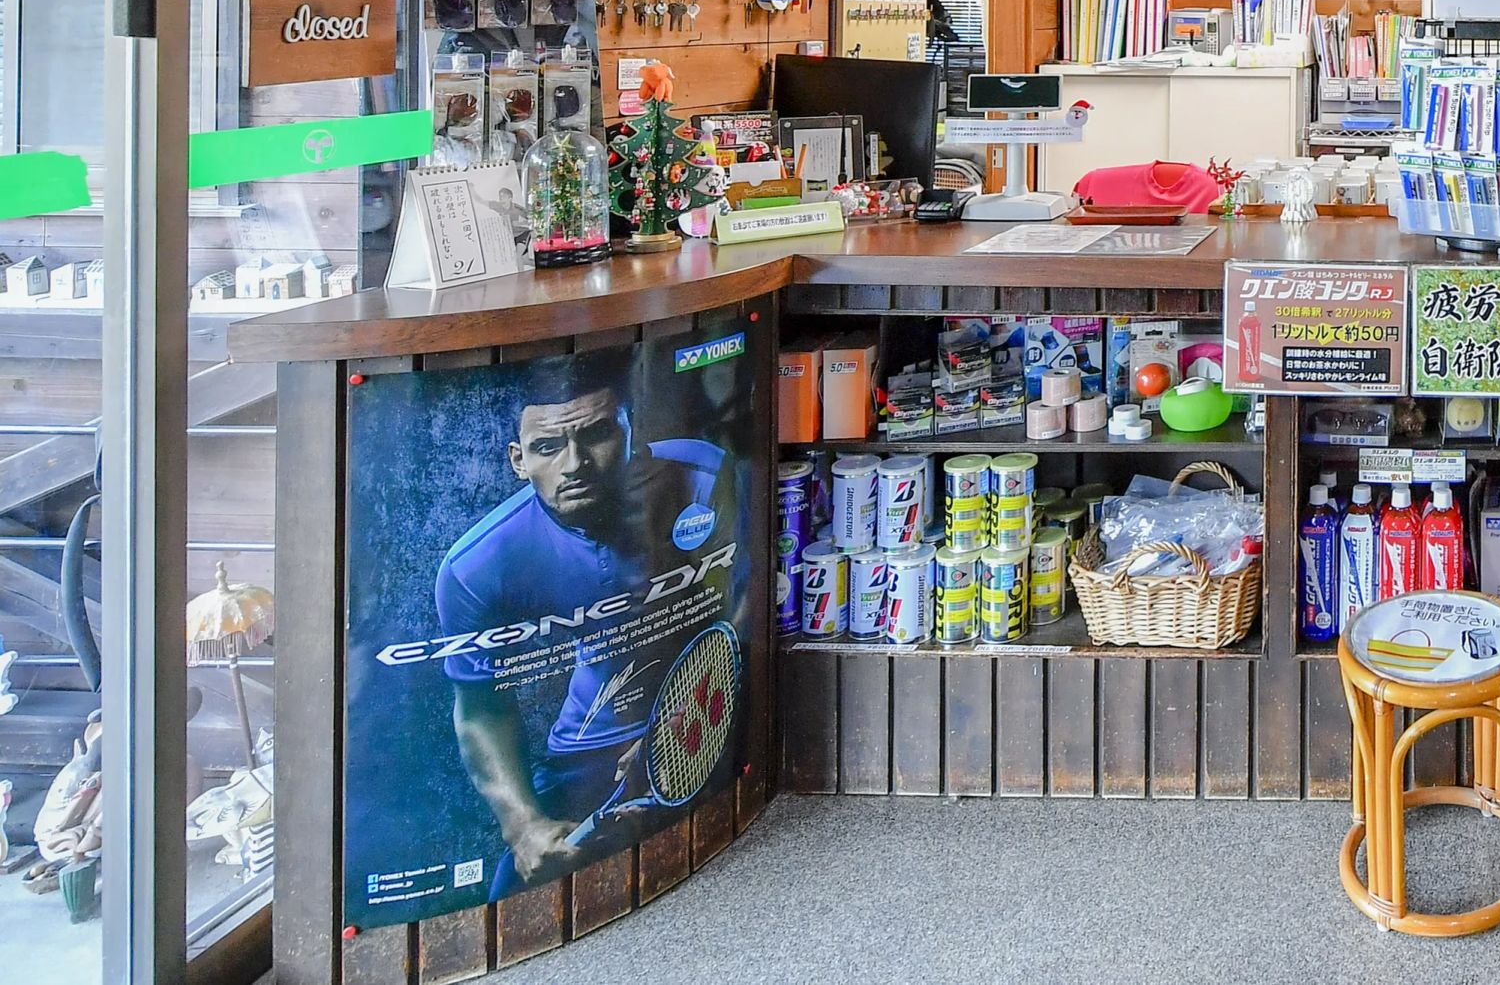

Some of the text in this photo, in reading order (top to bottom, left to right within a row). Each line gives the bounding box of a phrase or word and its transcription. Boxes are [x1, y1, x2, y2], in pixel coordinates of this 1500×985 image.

[283, 4, 371, 43] closed
[1239, 279, 1393, 301] クエン酸コンク RJ
[1275, 306, 1322, 317] 30倍希釈
[1335, 307, 1392, 319] 27リットル分
[1271, 324, 1399, 343] 1リットルで約50円
[705, 336, 741, 360] YONEX
[676, 523, 711, 537] BLUE
[376, 542, 737, 666] EZONE DR
[1401, 599, 1480, 615] 手荷物置きに
[495, 586, 715, 667] It generates power and has great control, giving me the
[1401, 609, 1500, 628] ご利用ください。
[494, 592, 723, 679] confidence to take those risky shots and play aggressively.
